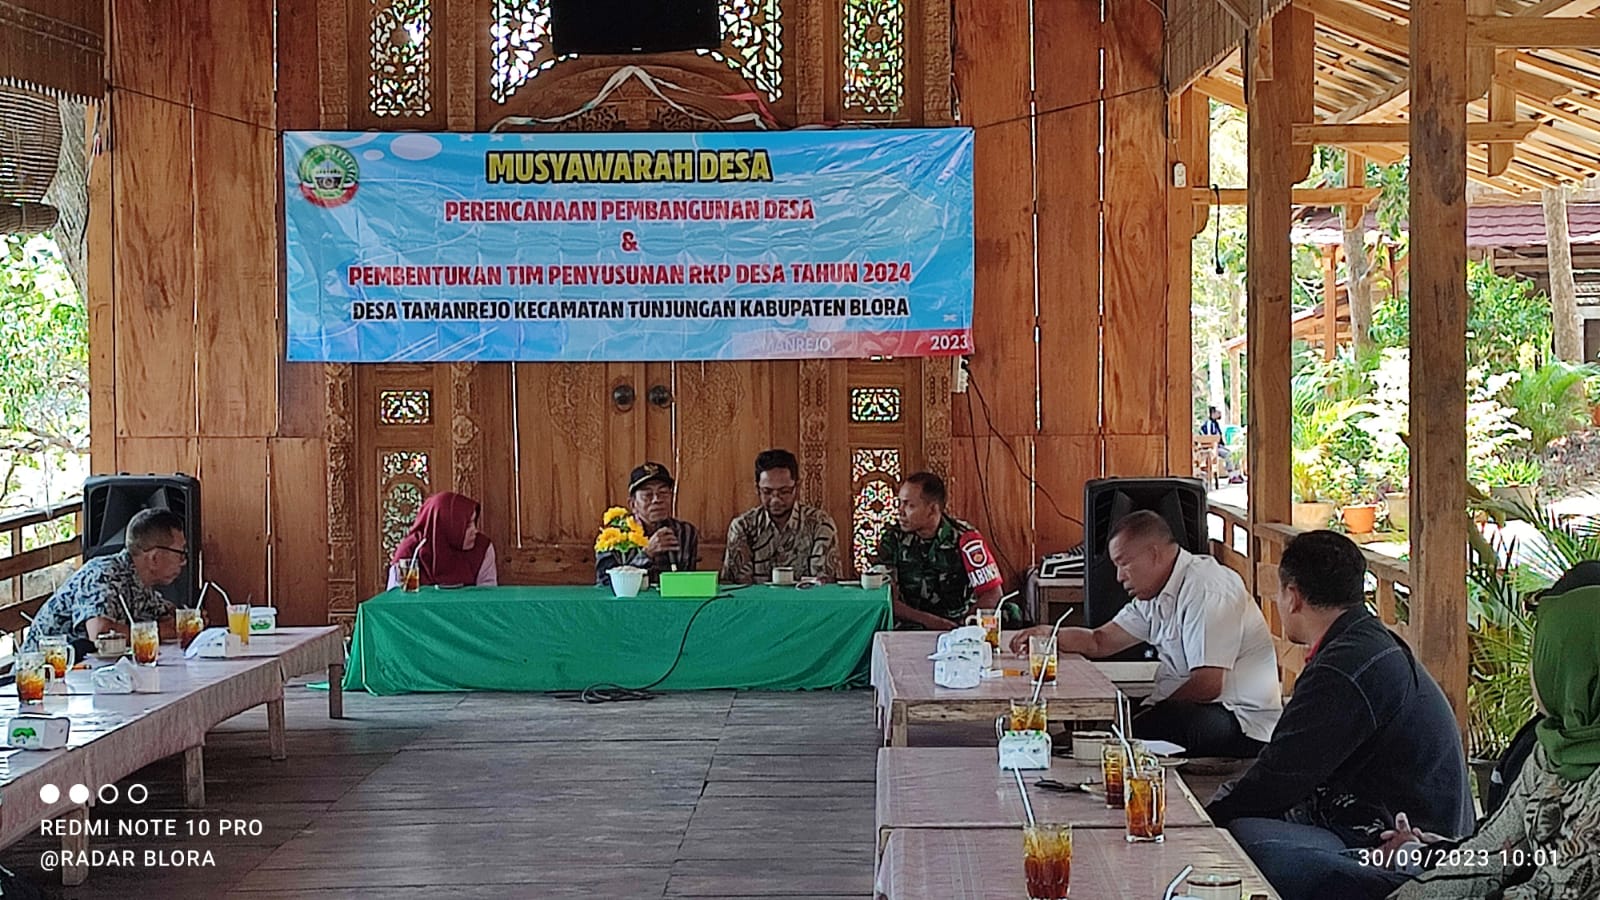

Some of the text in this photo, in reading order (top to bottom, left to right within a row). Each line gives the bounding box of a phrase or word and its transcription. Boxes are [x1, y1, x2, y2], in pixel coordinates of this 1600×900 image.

[486, 150, 772, 183] MUSYAWARAH DESA
[446, 200, 815, 221] PERENCANAAN PEMBANGUNAN DESA
[622, 231, 638, 251] &
[349, 263, 912, 285] PEMBENTUKAN TIM PENYUSUNAN RKP DESA TAHUN 2024
[353, 298, 909, 320] DESA TAMANREJO KECAMATAN TUNJUNGAN KABUPATEN BLORA
[930, 335, 968, 350] 2023
[967, 562, 1001, 588] ABINS
